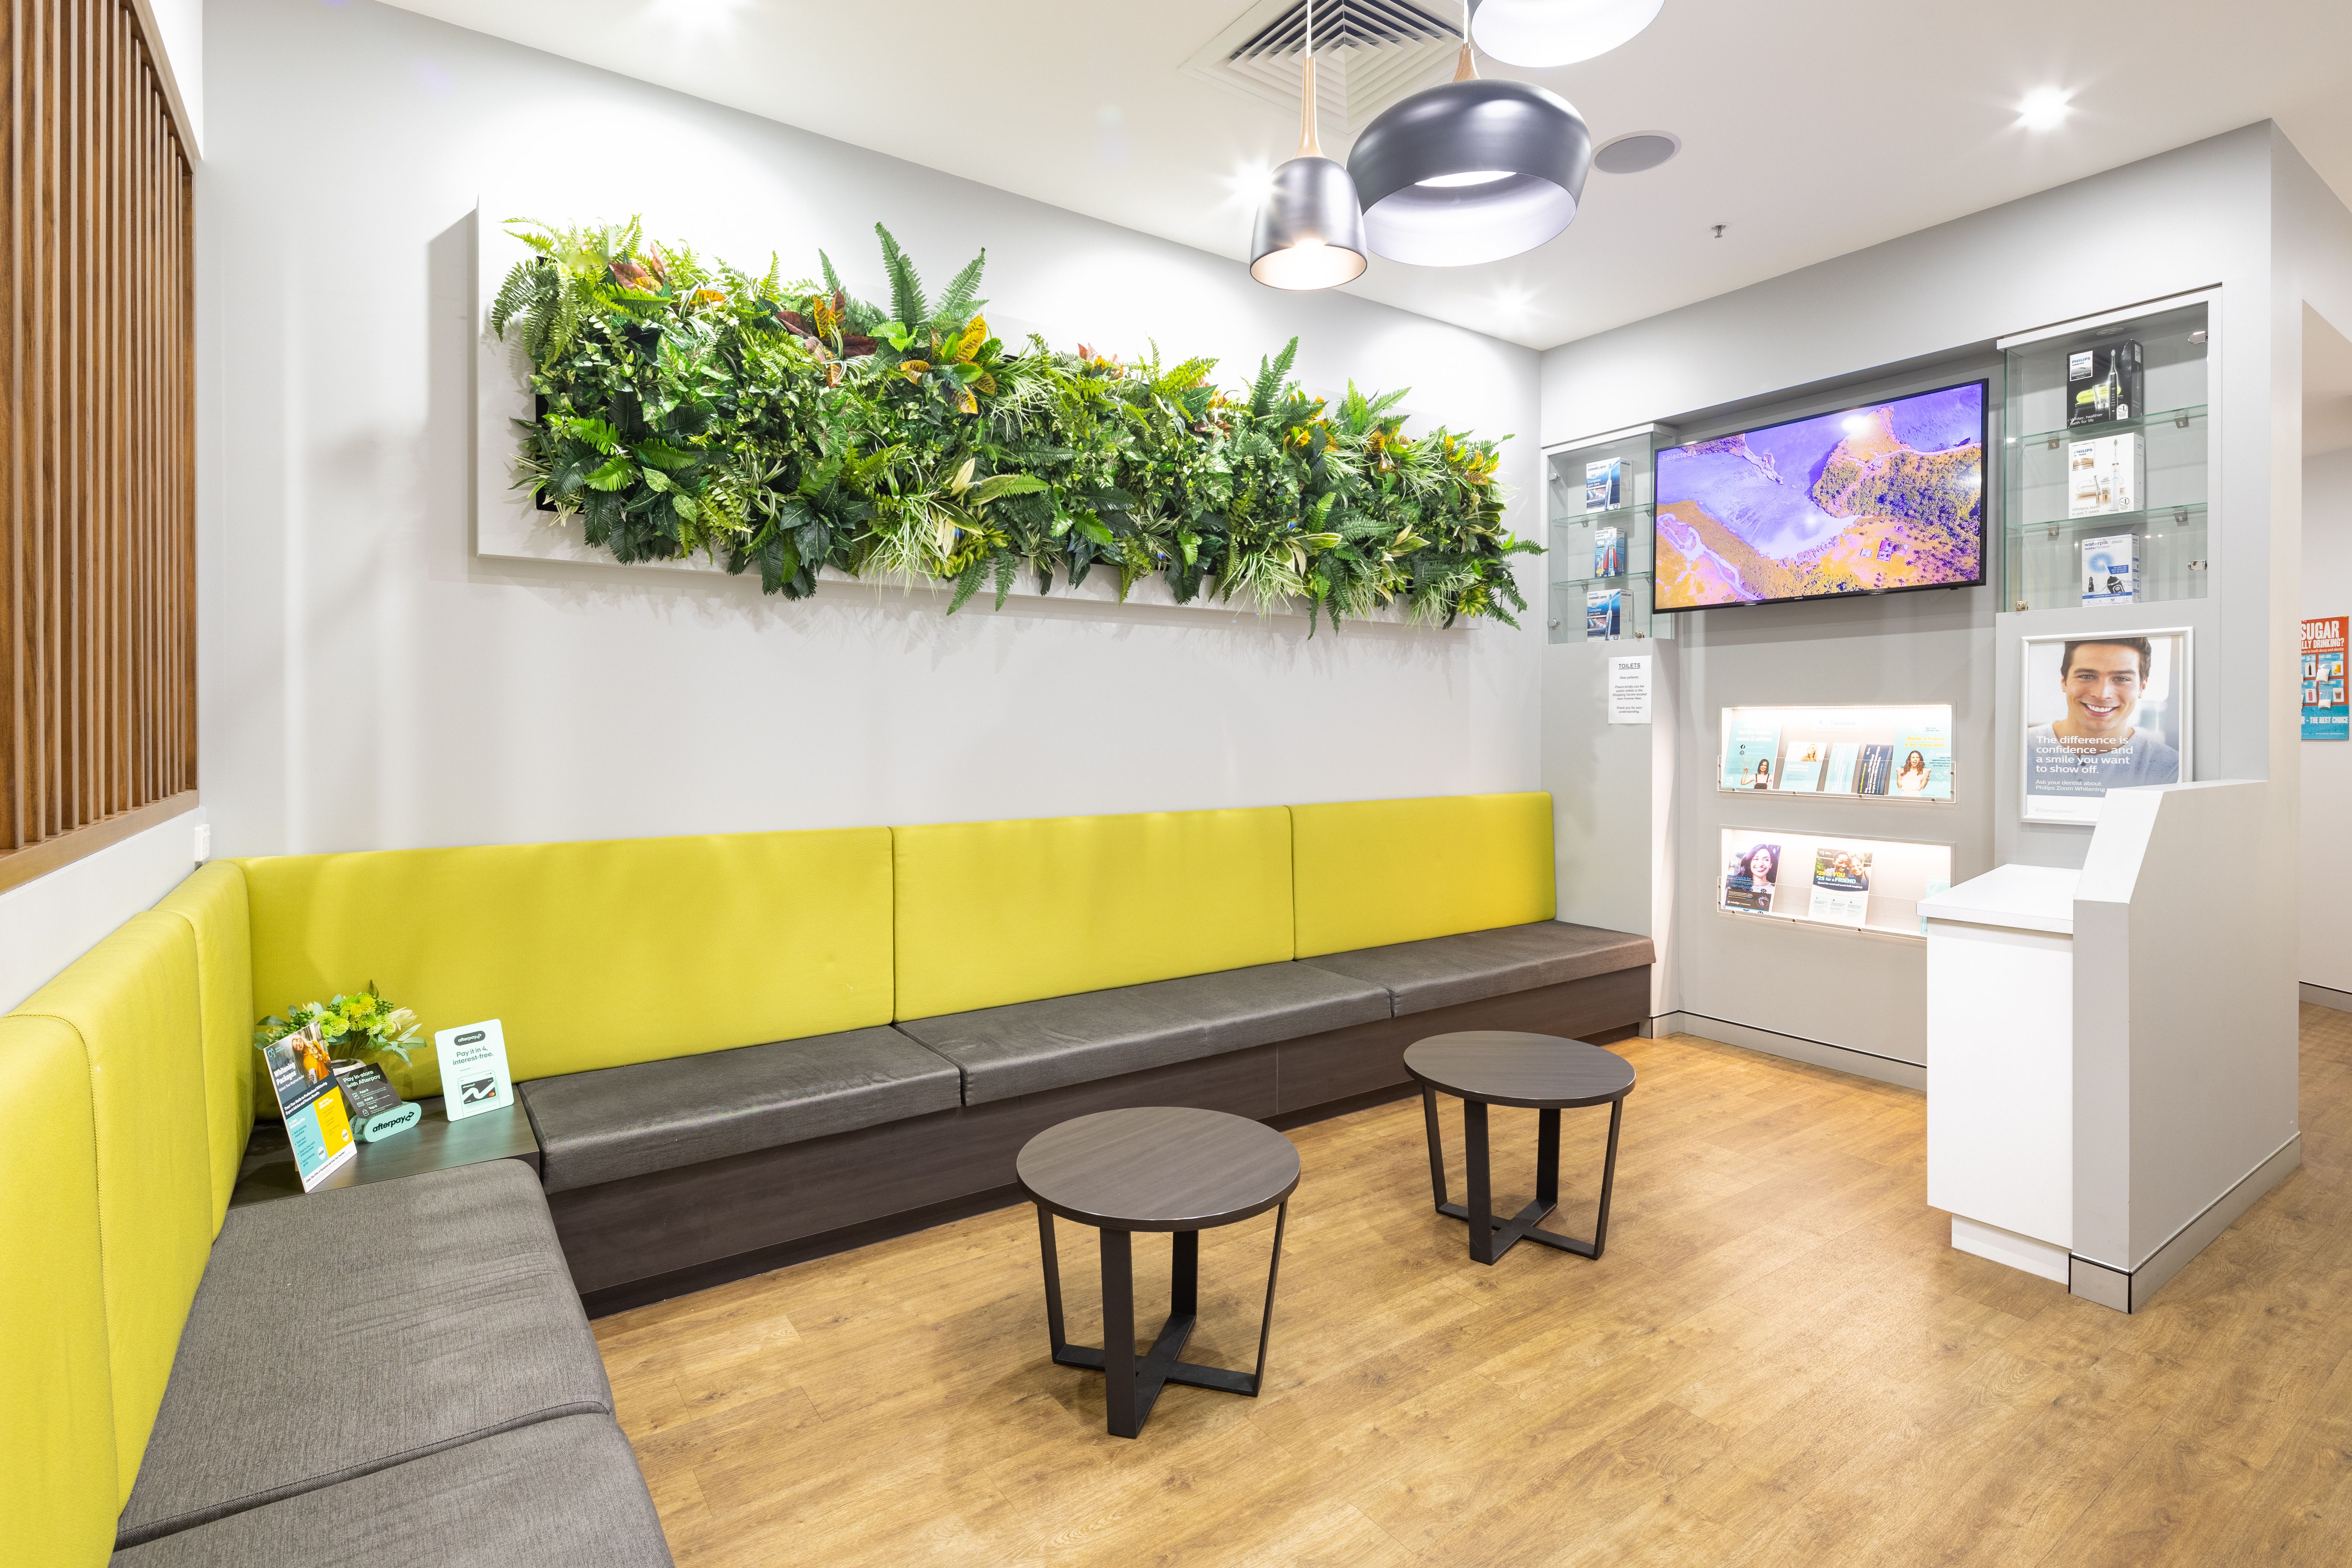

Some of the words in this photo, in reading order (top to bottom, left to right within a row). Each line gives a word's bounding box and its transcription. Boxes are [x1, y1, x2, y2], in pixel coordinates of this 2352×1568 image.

[1663, 449, 1691, 461] Selected
[2301, 621, 2339, 640] SUGAR
[2313, 638, 2344, 648] DRINKING?
[2060, 736, 2116, 744] difference
[2111, 746, 2133, 754] and
[453, 1052, 493, 1065] interest-free.
[274, 1062, 296, 1077] Whitening
[354, 1070, 374, 1079] in-store
[276, 1070, 297, 1086] Packages
[359, 1075, 380, 1084] Afterpay
[304, 1087, 317, 1098] Professional
[373, 1116, 405, 1132] afterpay
